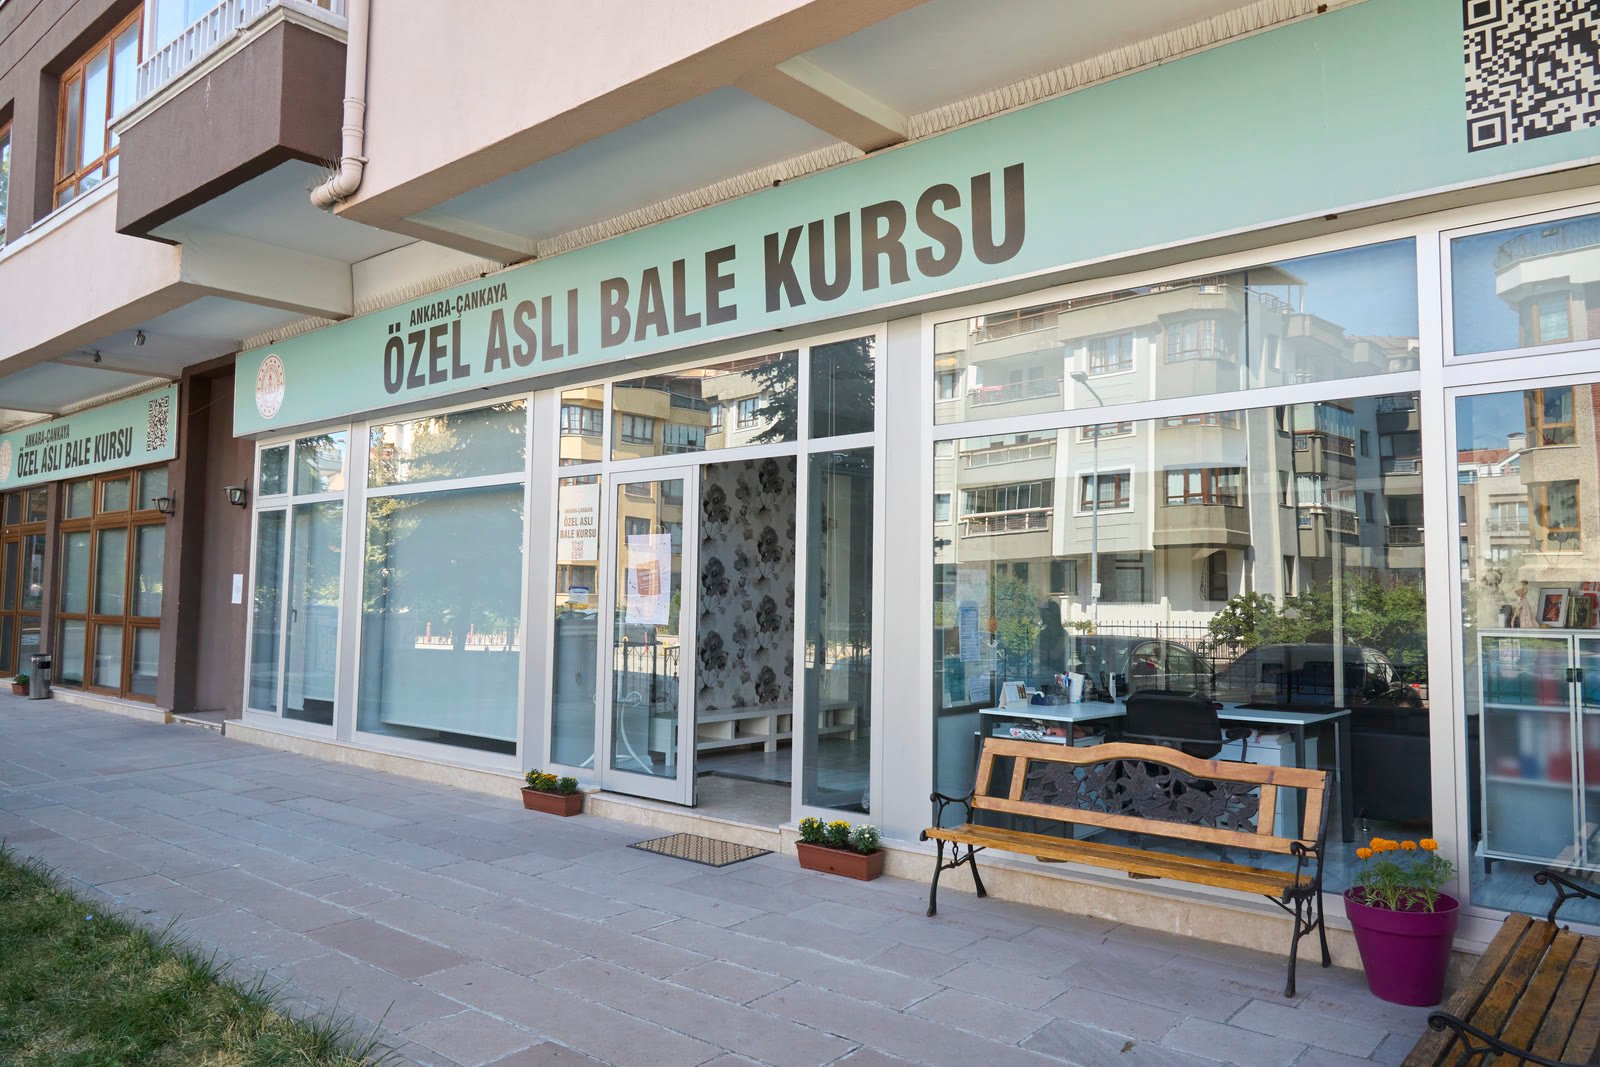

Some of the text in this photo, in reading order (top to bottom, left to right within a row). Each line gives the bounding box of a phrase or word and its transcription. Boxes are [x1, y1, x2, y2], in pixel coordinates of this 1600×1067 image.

[383, 318, 471, 395] ÖZEL
[484, 288, 579, 373] ASLI
[600, 244, 738, 349] BALE
[764, 162, 1026, 313] KURSU
[409, 282, 508, 327] ANKARA-ÇANKAYA
[17, 426, 133, 478] ÖZEL ASLI BALE KURSU
[25, 424, 70, 449] ANKARA-ÇANKAYA
[560, 528, 597, 538] BALE KURSU
[564, 516, 593, 526] ÖZEL ASLI
